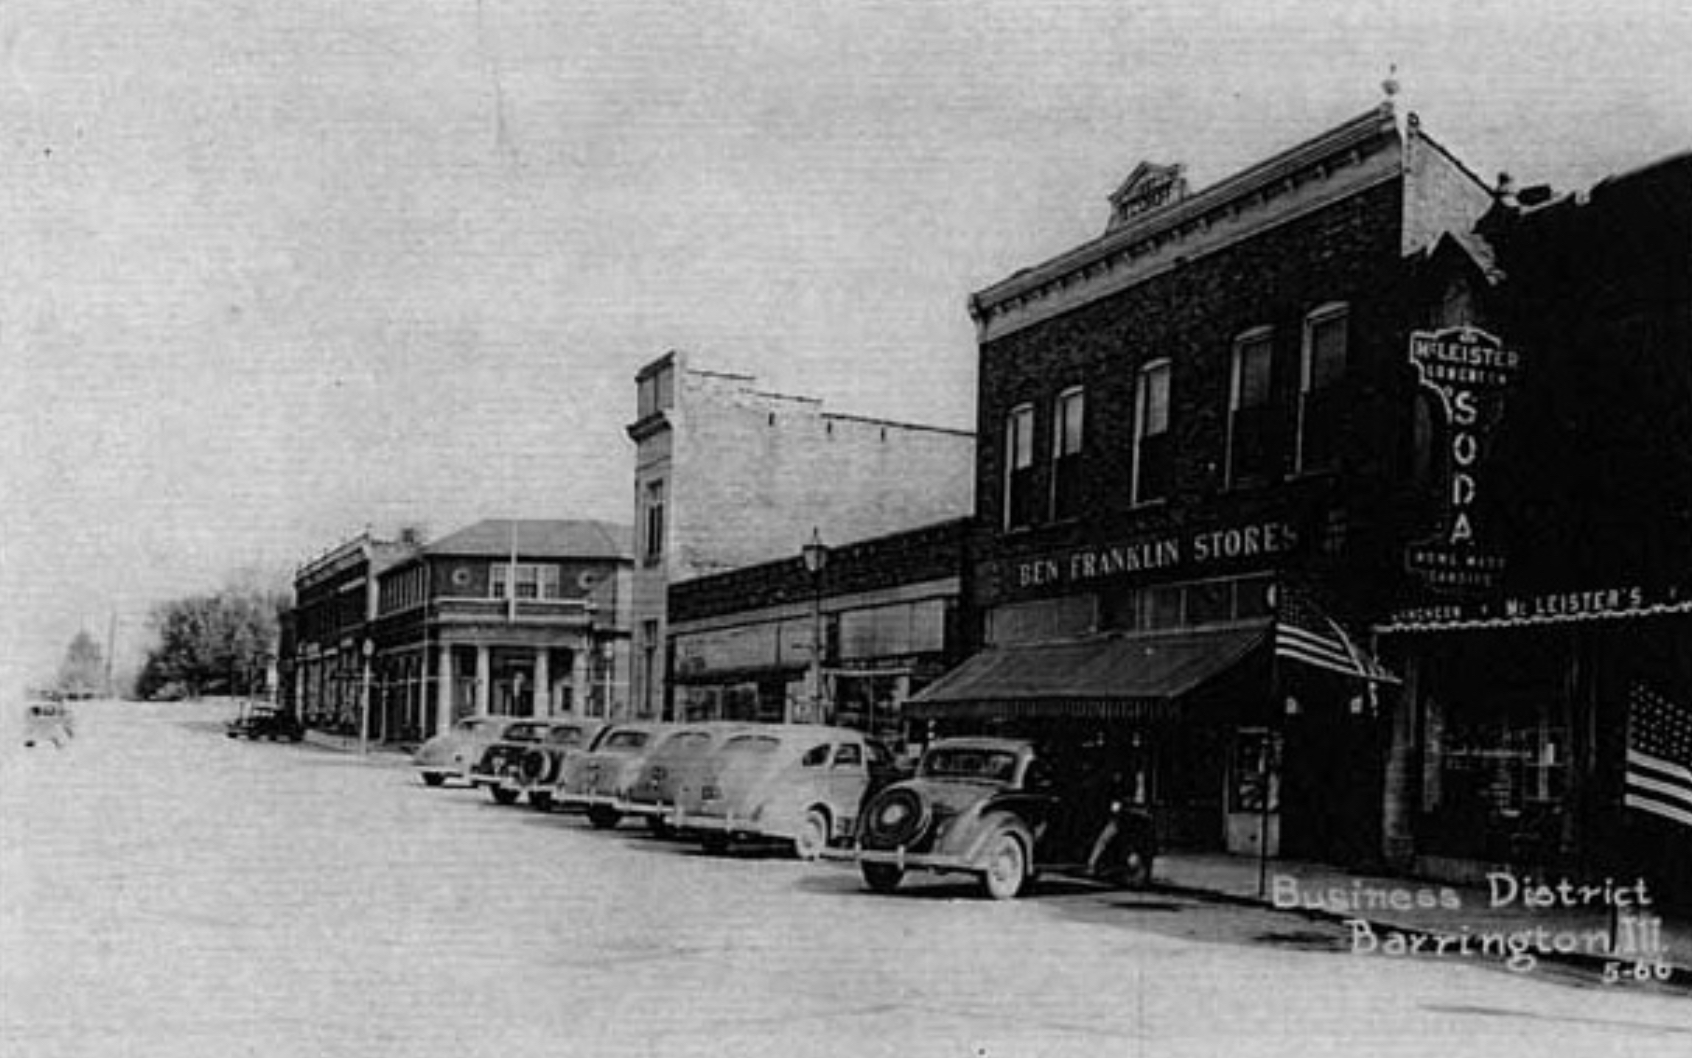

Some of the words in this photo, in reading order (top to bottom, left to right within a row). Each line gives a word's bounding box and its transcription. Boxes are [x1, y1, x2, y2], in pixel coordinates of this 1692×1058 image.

[1450, 390, 1478, 545] SODA
[1019, 560, 1059, 588] BEN
[1070, 538, 1180, 581] FRANKLIN
[1193, 521, 1298, 562] STORES
